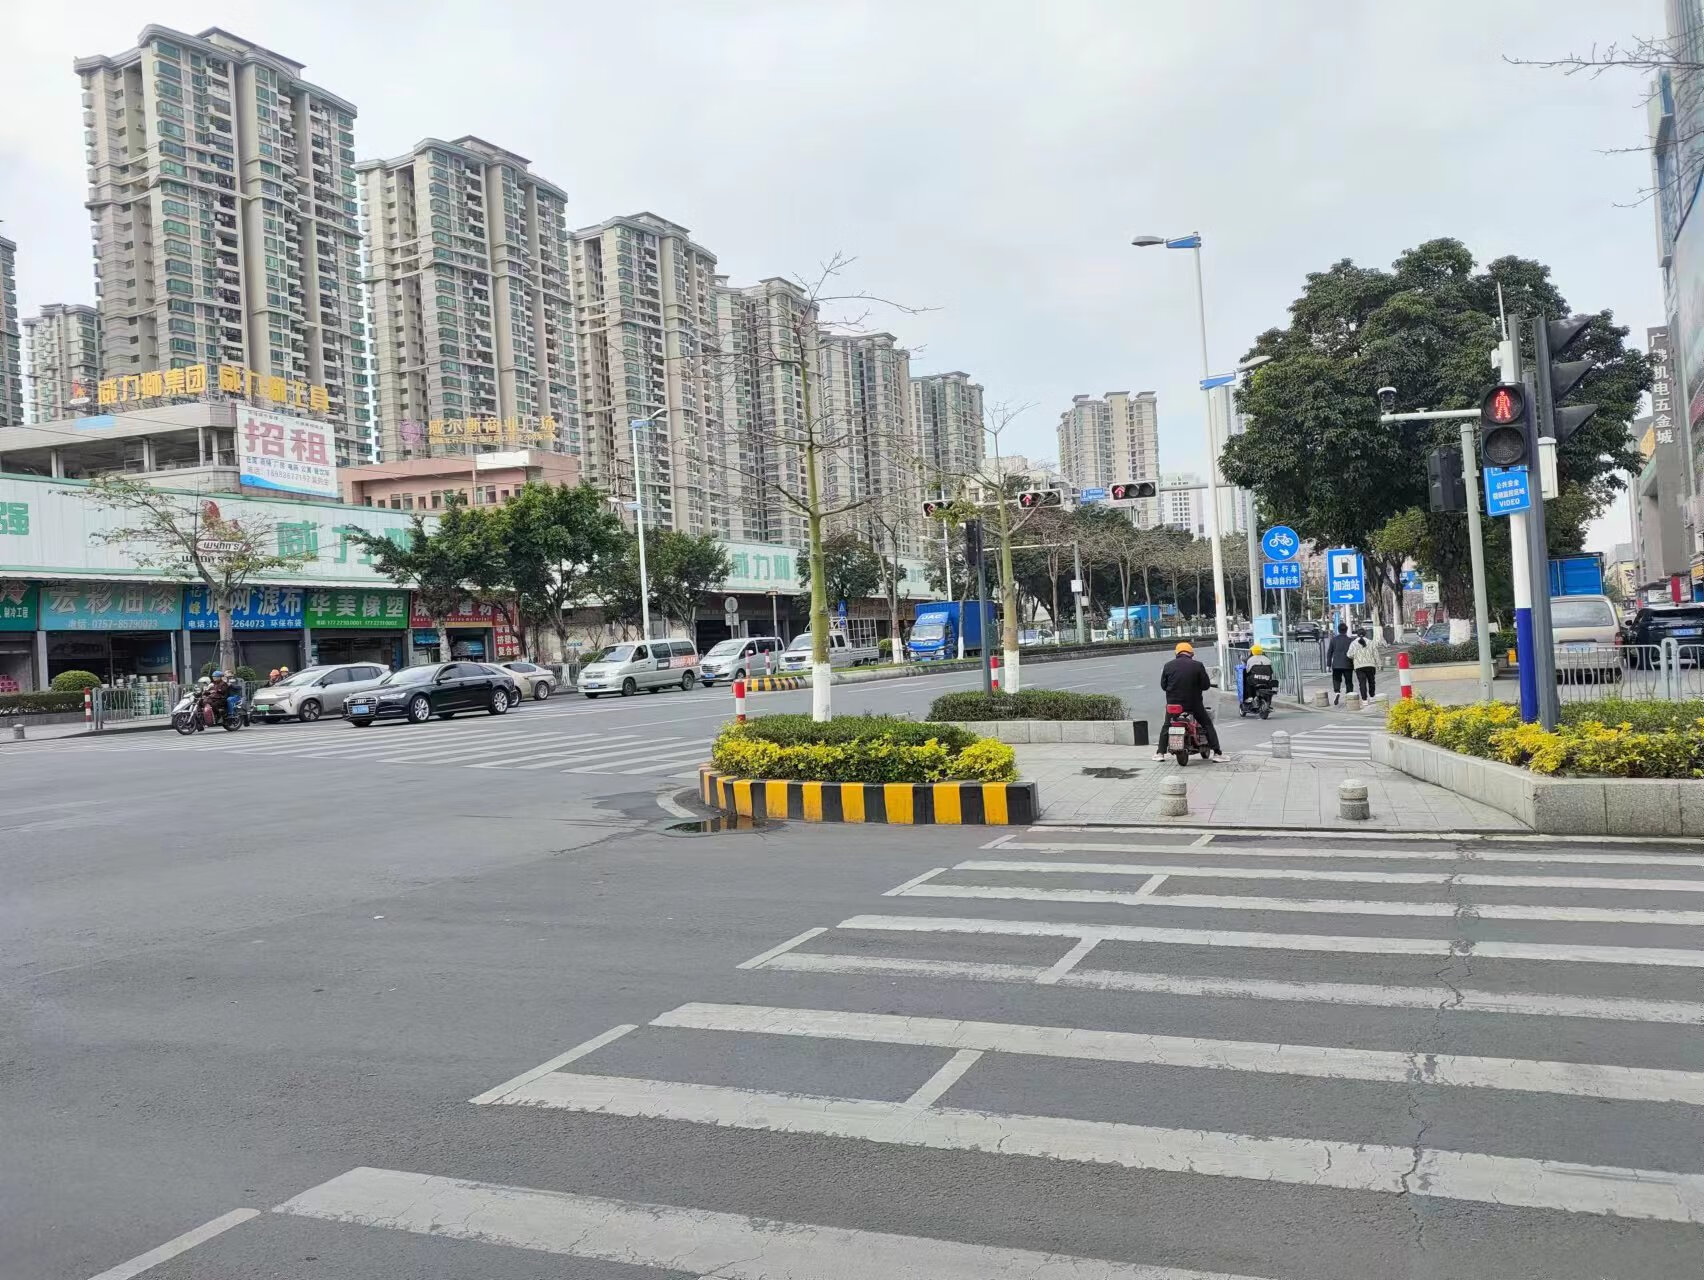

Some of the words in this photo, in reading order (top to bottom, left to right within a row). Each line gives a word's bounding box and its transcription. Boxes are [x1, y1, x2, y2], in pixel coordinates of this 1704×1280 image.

[1650, 333, 1674, 444] 广佛机电五金城
[244, 417, 329, 466] 招租
[1499, 498, 1521, 507] VIDEO
[1273, 564, 1297, 574] 自行车
[1266, 577, 1299, 586] 电动自行车
[1332, 580, 1360, 592] 加油站
[309, 594, 404, 617] 华美橡塑
[270, 619, 302, 627] 环保布袋
[498, 646, 520, 656] 复合板
